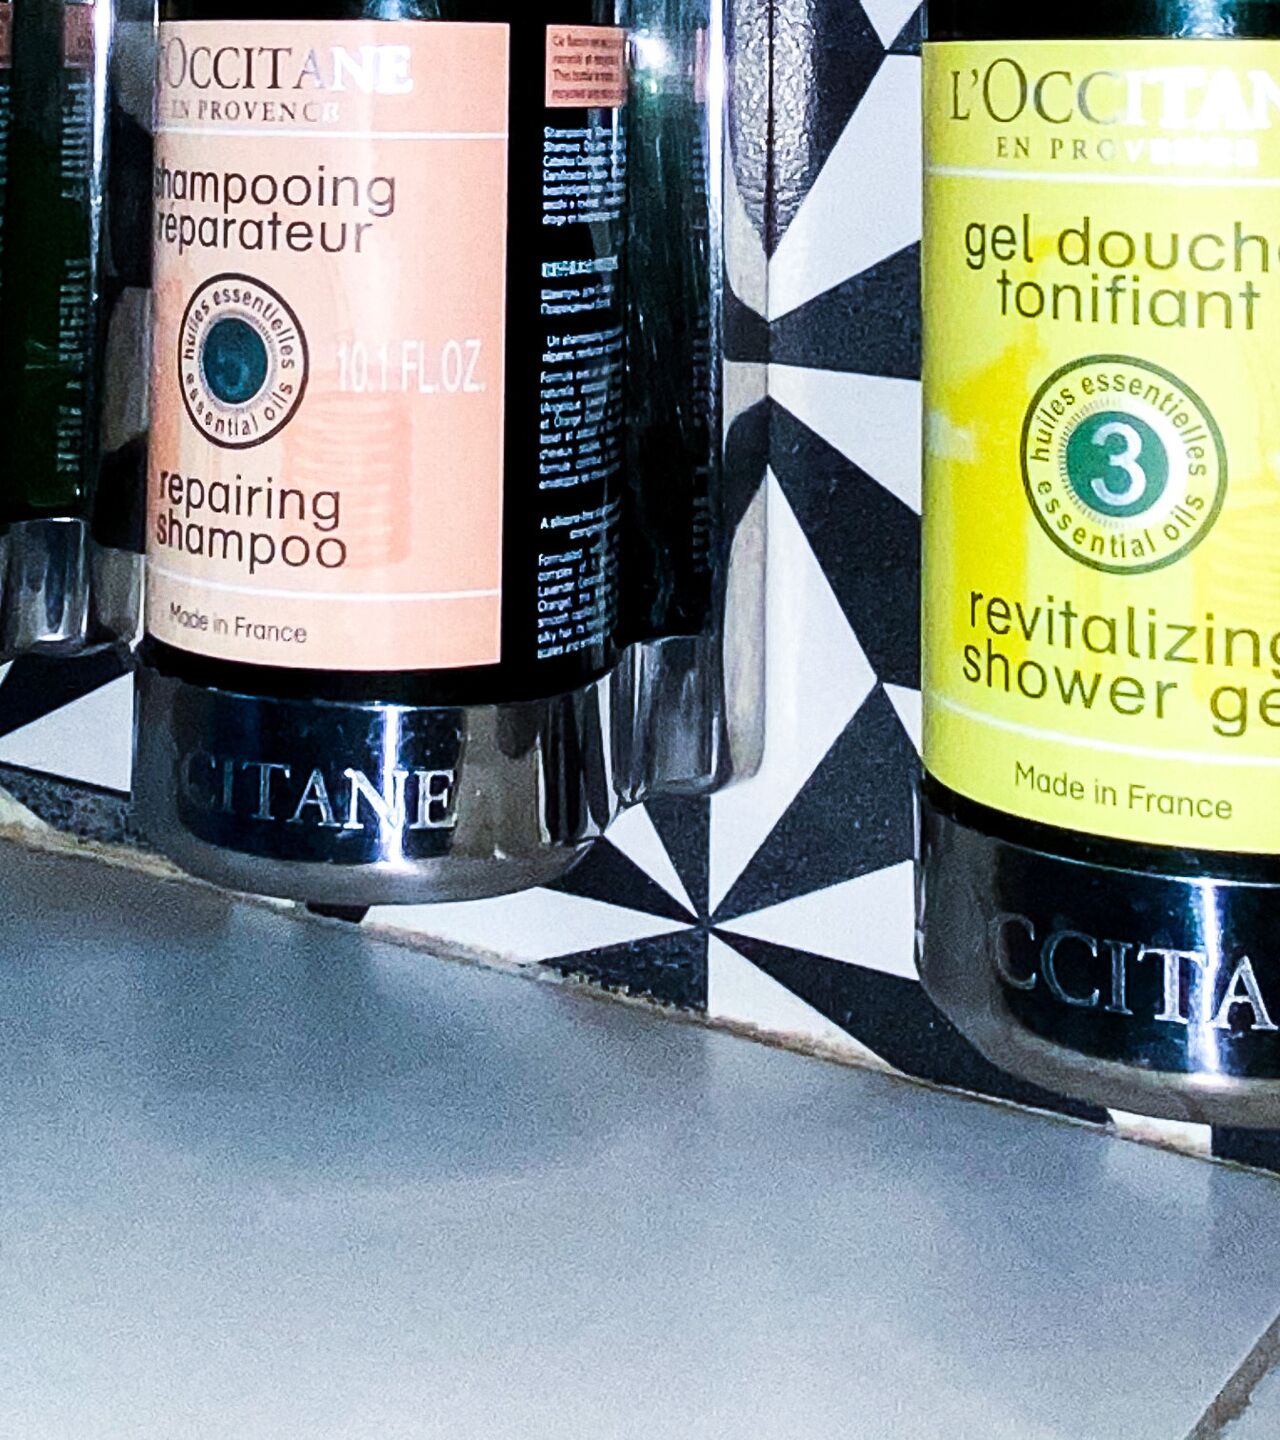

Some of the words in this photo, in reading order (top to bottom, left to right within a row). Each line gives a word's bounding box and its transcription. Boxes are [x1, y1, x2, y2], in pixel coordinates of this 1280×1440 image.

[997, 136, 1030, 160] EN
[158, 201, 373, 255] réparateur
[965, 213, 1034, 271] gel
[183, 299, 210, 360] huiles
[212, 287, 295, 370] essentielles
[996, 269, 1262, 331] tonifiant
[336, 340, 389, 394] 10.1
[186, 373, 259, 437] essential
[264, 382, 294, 422] oils
[1030, 386, 1077, 463] huiles
[1081, 372, 1208, 478] essentielles
[1090, 421, 1147, 507] 3
[160, 471, 340, 532] repairing
[1036, 481, 1156, 559] essential
[1165, 494, 1206, 543] oils
[157, 508, 347, 574] shampoo
[170, 602, 209, 631] Made
[213, 613, 228, 635] in
[235, 616, 307, 643] France
[962, 638, 1178, 719] shower
[1015, 760, 1085, 800] Made
[1094, 778, 1118, 806] in
[1128, 783, 1233, 820] France
